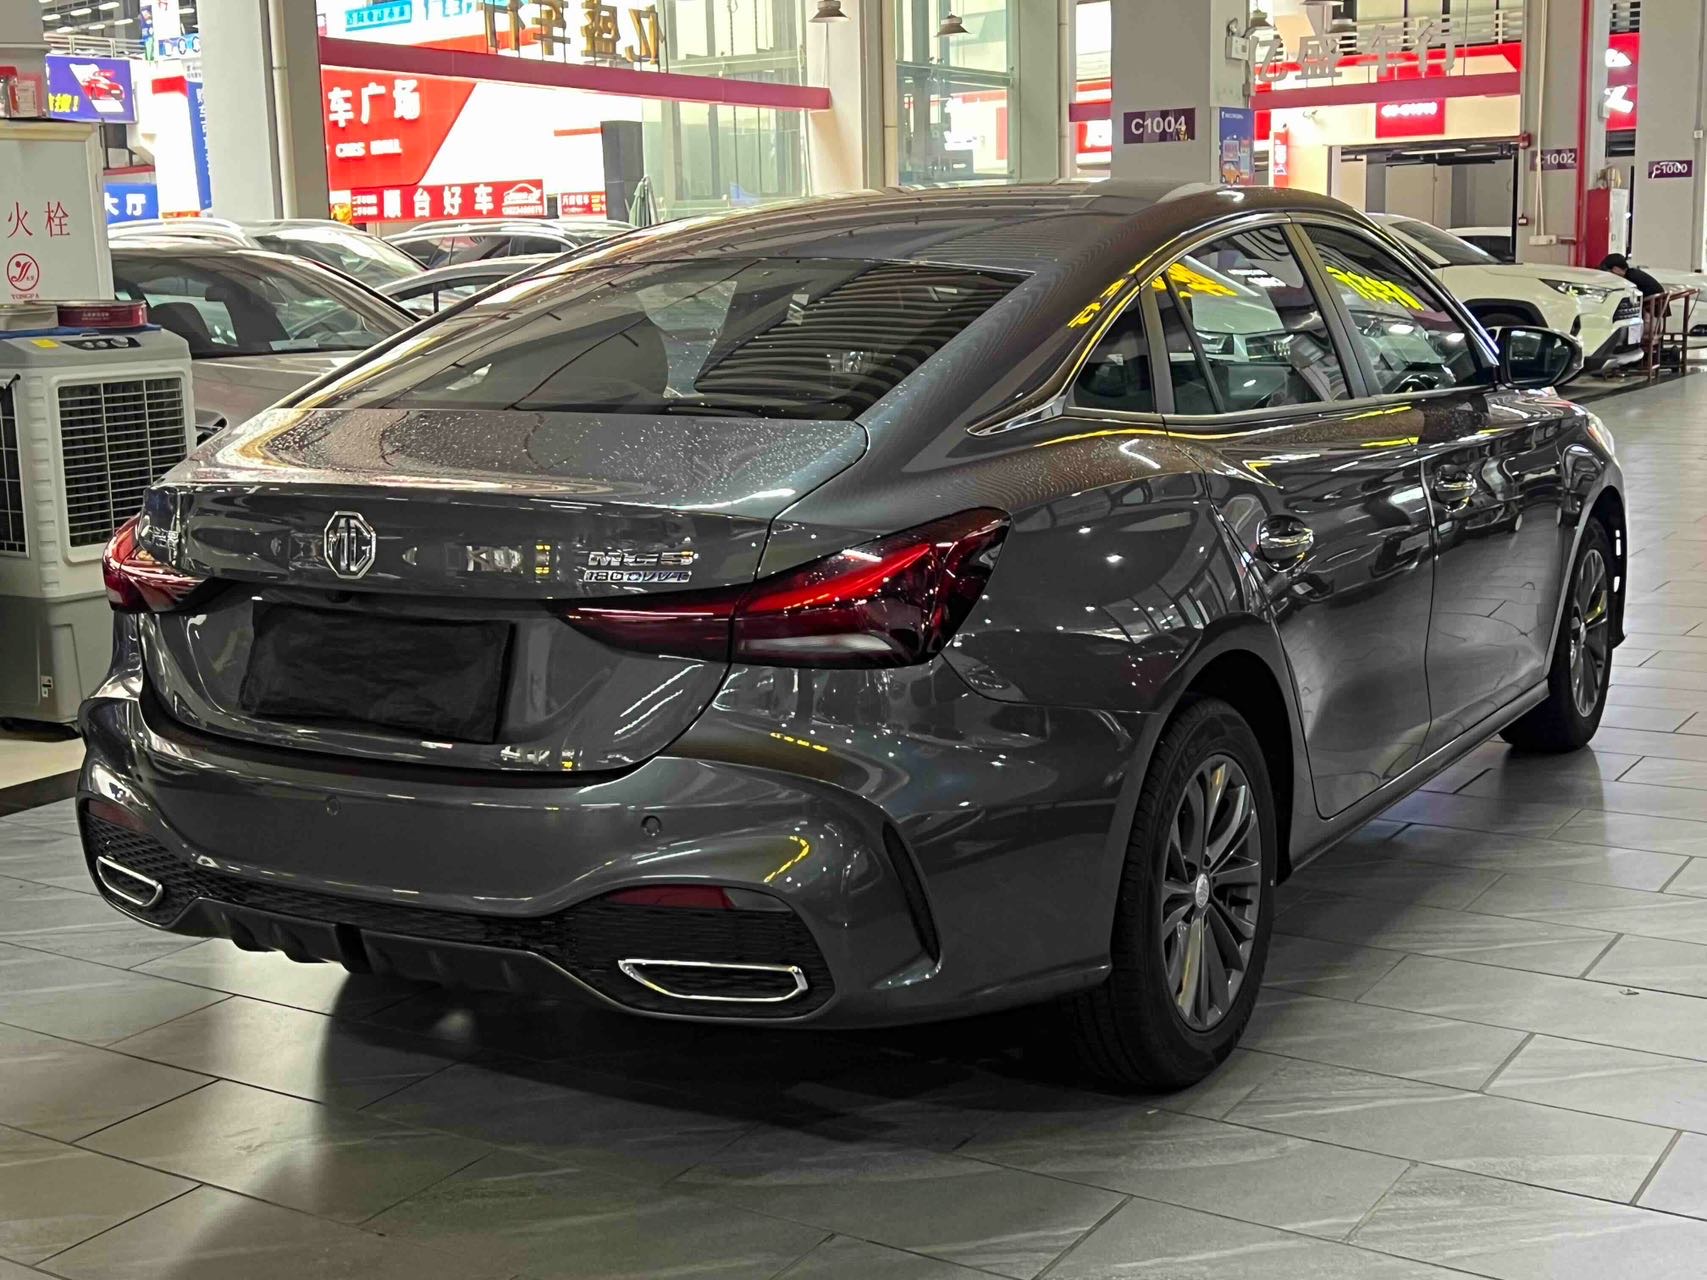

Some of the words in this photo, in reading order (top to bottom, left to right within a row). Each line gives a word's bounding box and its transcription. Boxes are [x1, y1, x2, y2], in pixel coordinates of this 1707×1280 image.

[1248, 21, 1461, 82] 亿盛车行
[328, 79, 420, 128] 车广场
[1131, 115, 1186, 136] C1004
[1653, 164, 1688, 174] C1000
[7, 201, 71, 238] 火栓
[327, 516, 372, 574] MG
